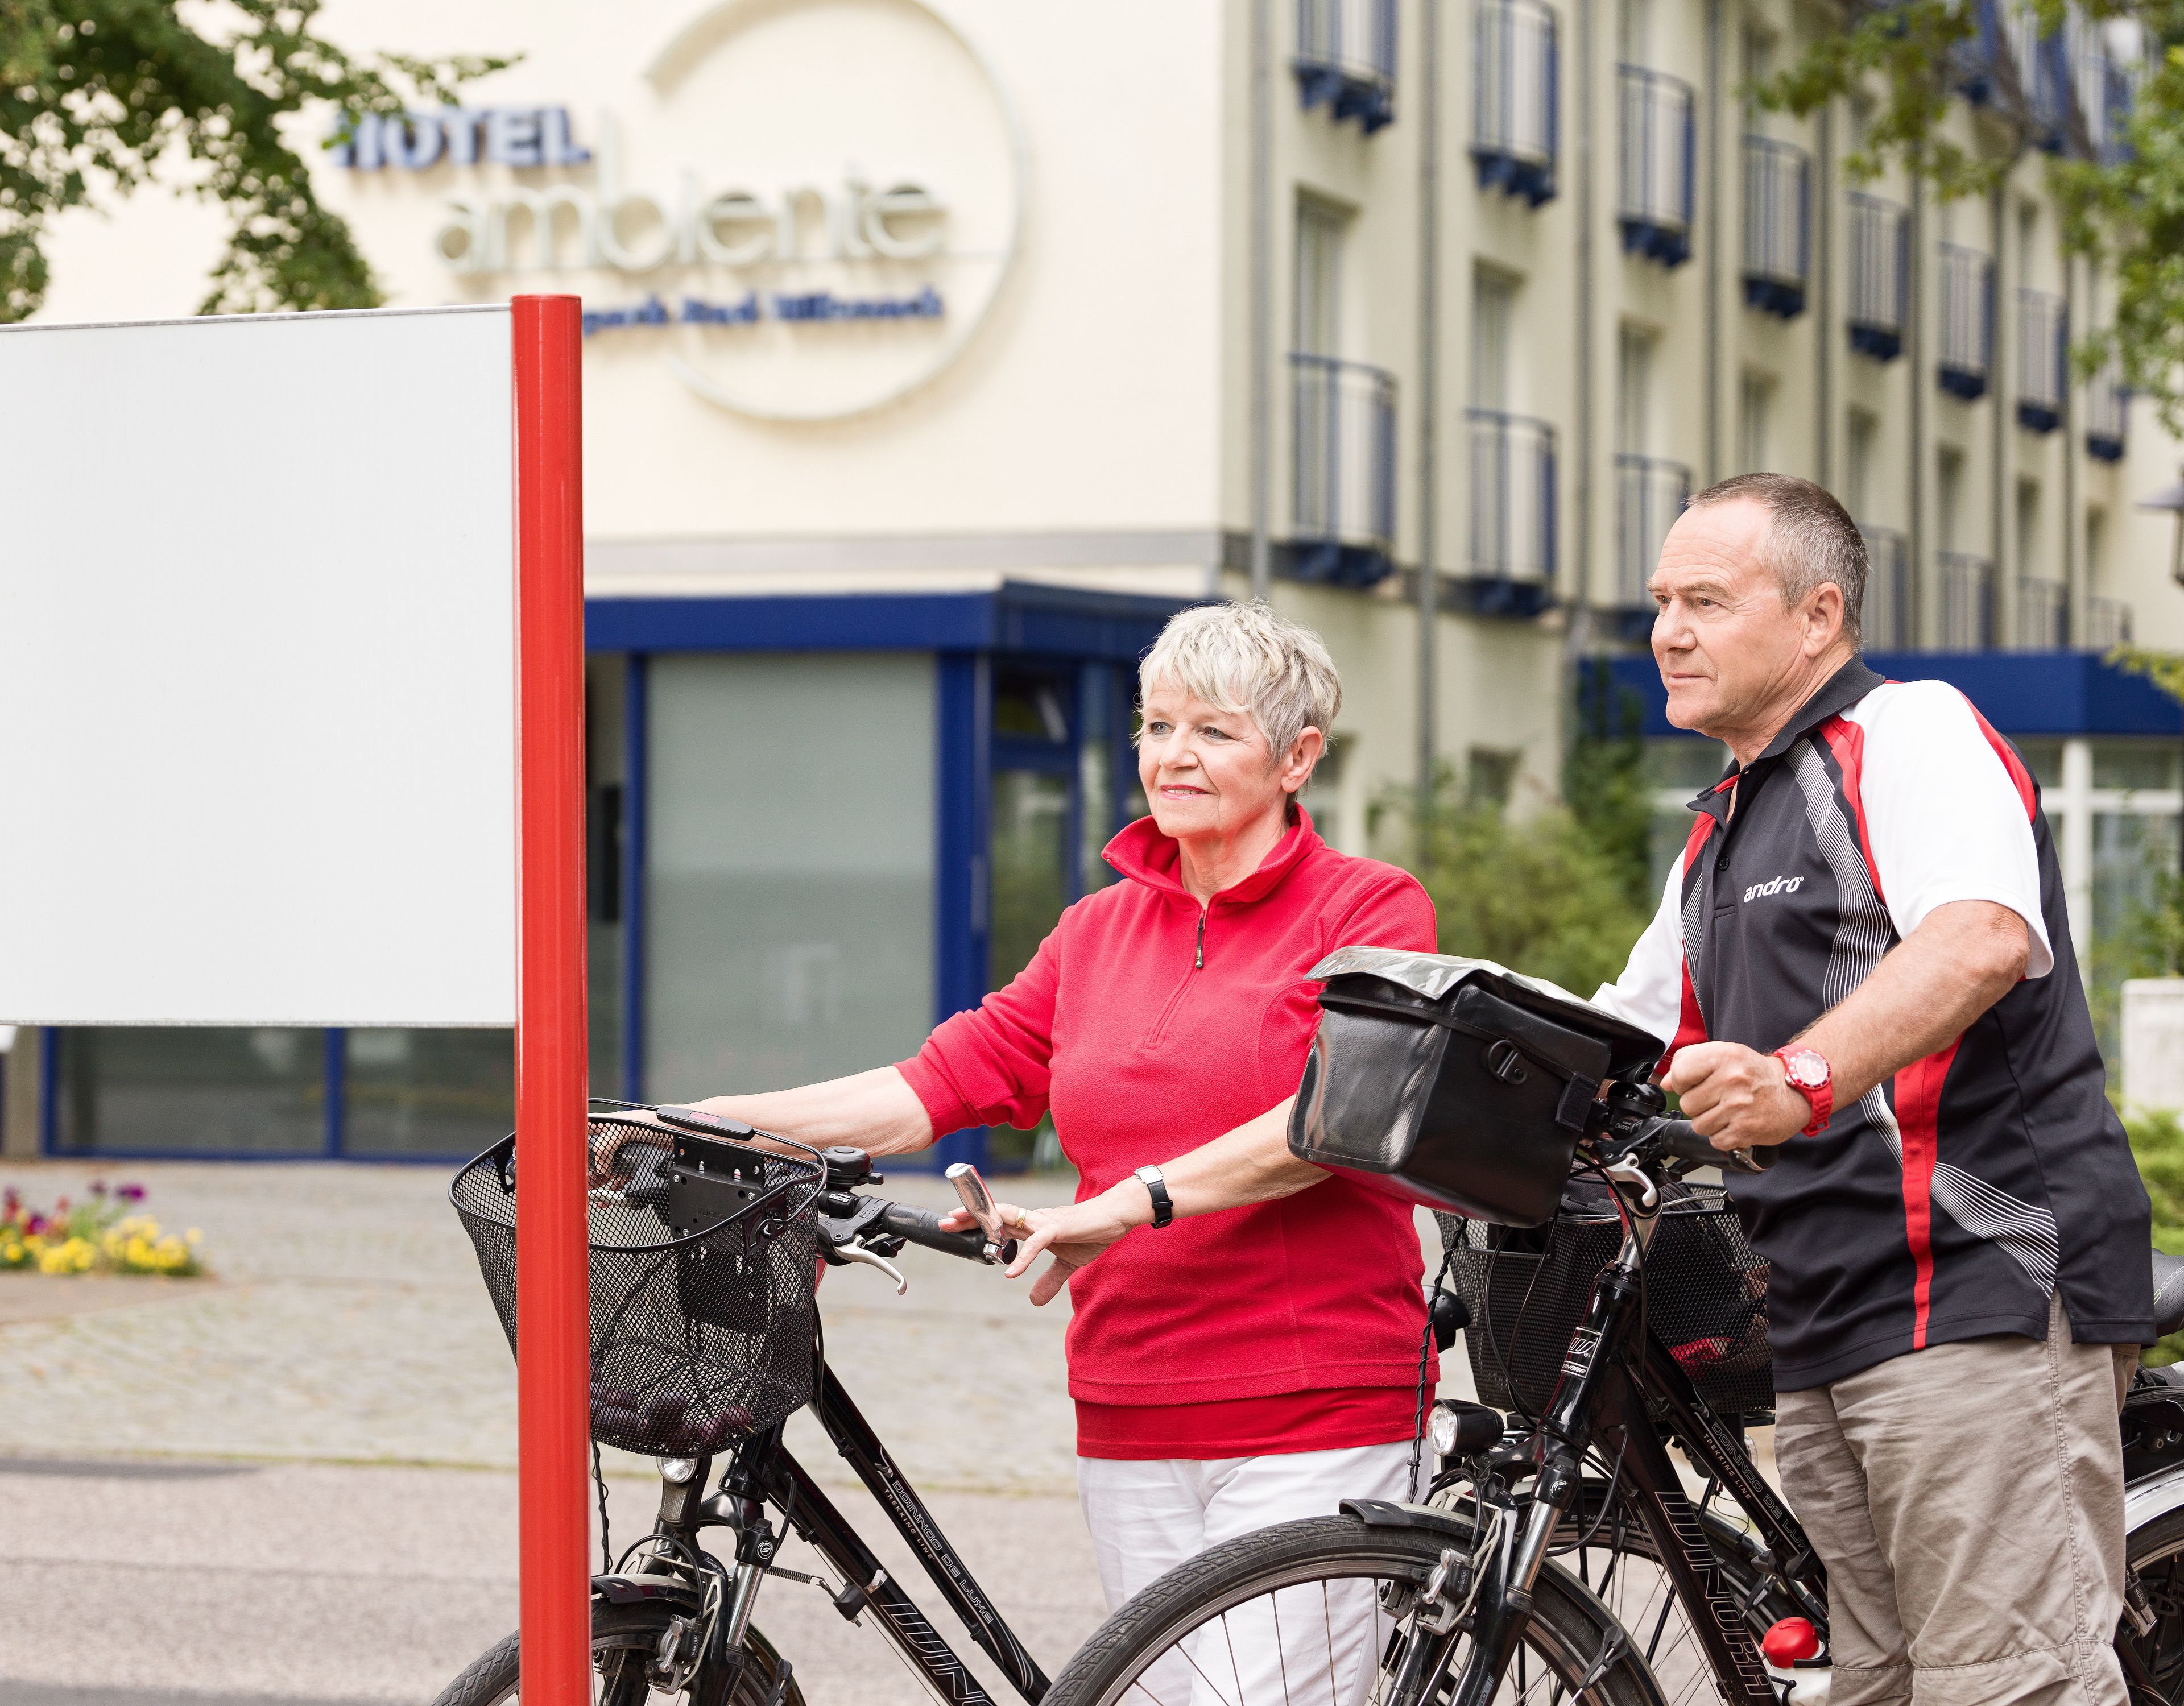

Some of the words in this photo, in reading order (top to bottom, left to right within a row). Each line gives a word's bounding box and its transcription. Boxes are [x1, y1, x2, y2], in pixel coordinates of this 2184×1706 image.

[330, 106, 592, 170] HOTEL
[433, 108, 948, 274] ambiente
[1743, 876, 1800, 903] andro
[1704, 1433, 1735, 1477] TREKKING
[1735, 1480, 1751, 1500] LINE
[884, 1488, 916, 1534] TREKKING
[917, 1538, 933, 1559] LINE
[1763, 1493, 1782, 1520] DE
[1782, 1519, 1806, 1549] LUX
[941, 1553, 961, 1578] DE
[959, 1579, 994, 1624] LUXE
[1458, 1571, 1467, 1592] MAGURA
[880, 1603, 994, 1706] WIN
